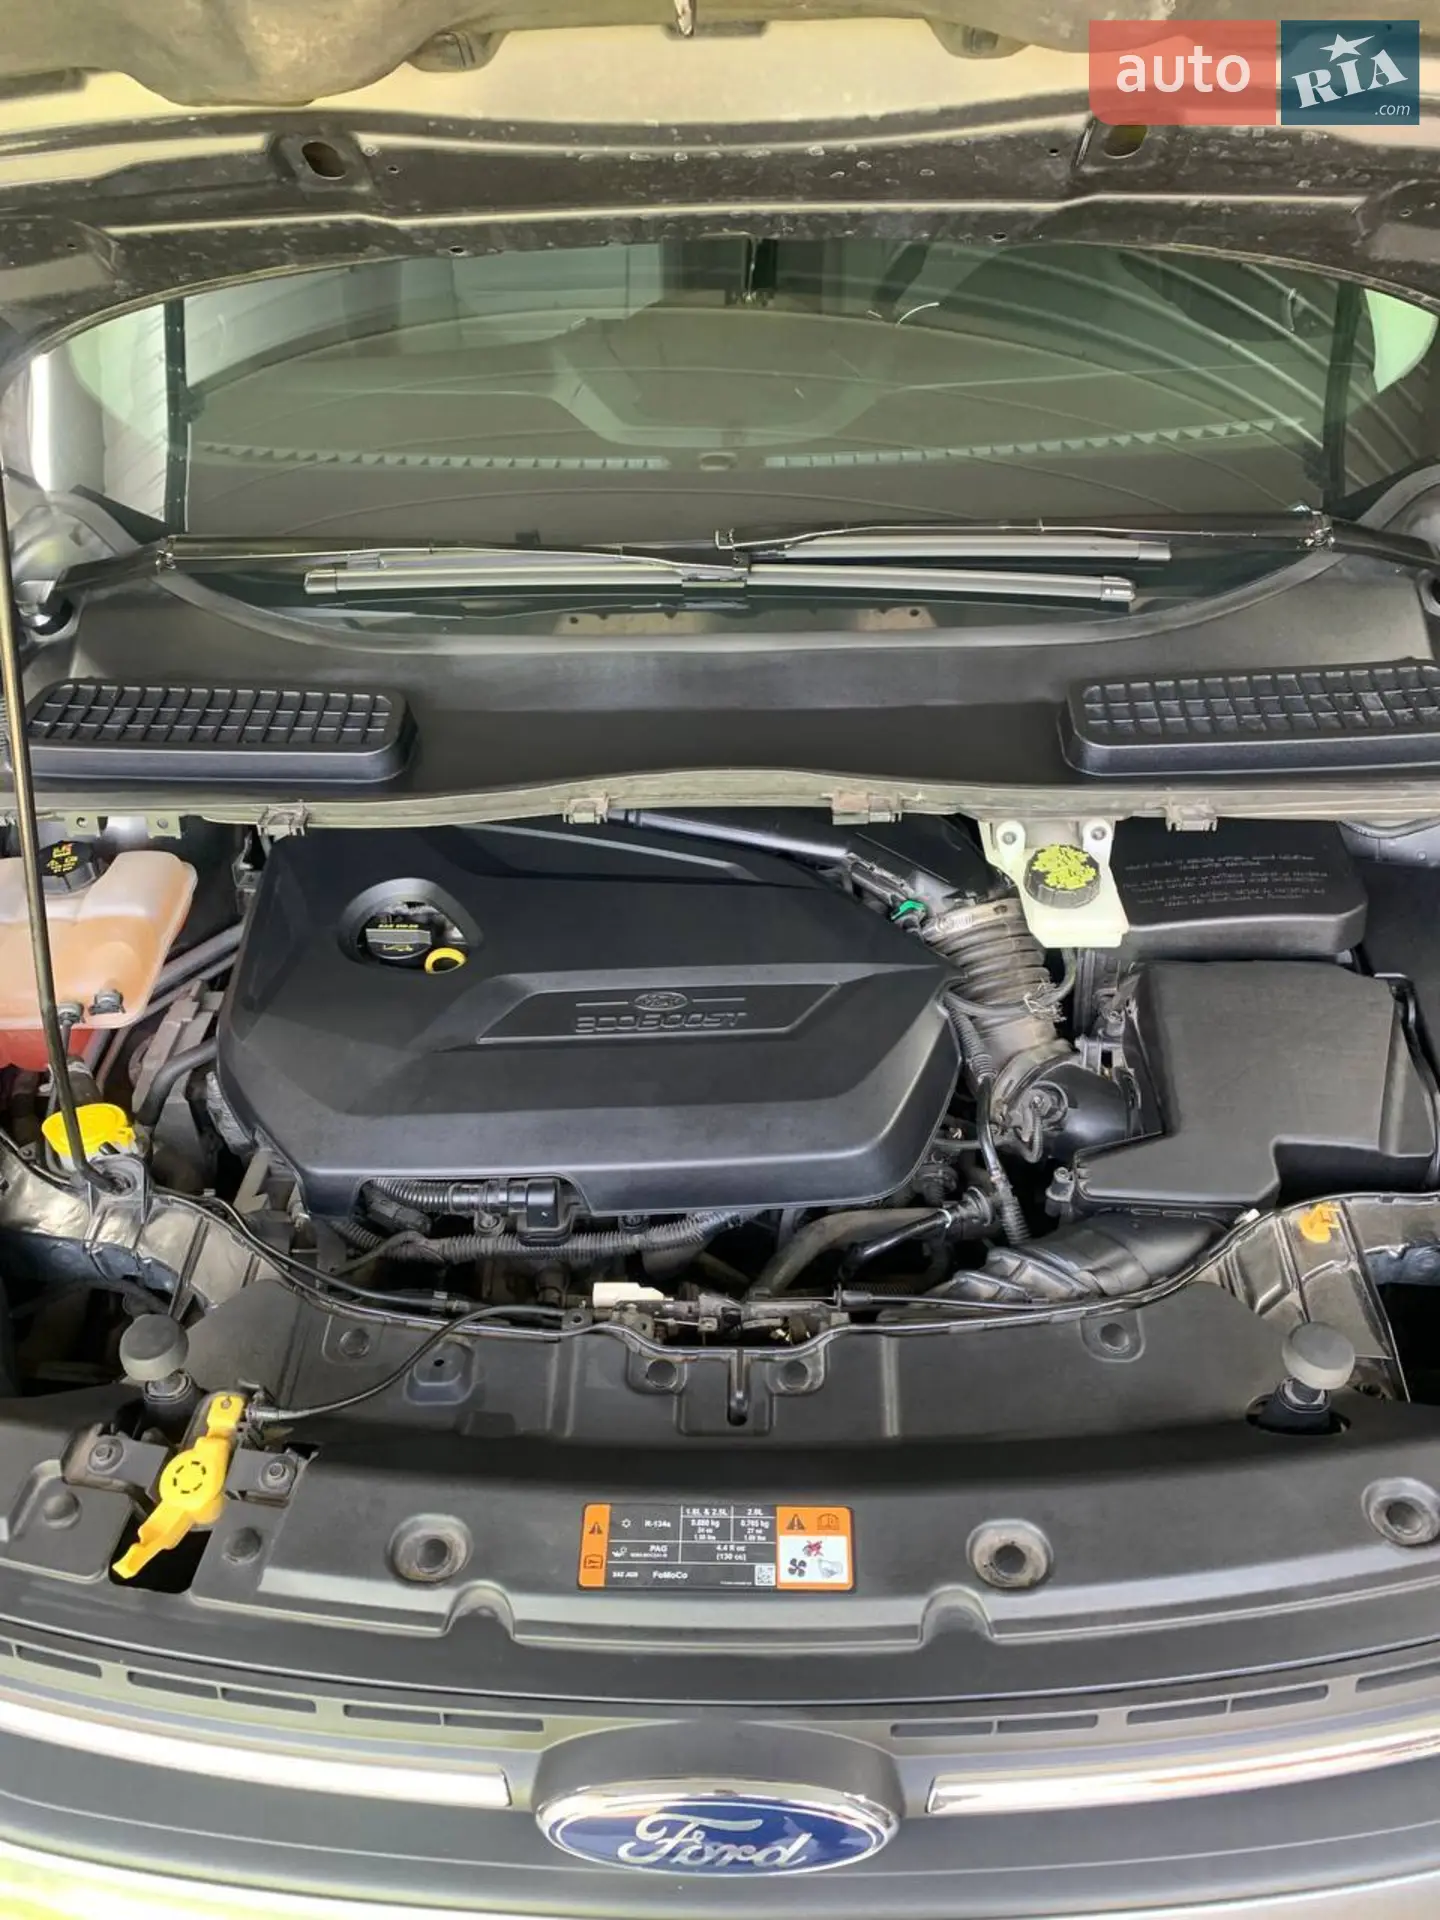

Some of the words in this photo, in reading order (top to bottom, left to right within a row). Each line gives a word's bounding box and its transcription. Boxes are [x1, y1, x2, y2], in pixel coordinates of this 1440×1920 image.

[649, 1544, 668, 1553] PAG
[652, 1570, 689, 1579] FoMoCo
[617, 1812, 815, 1867] Ford
